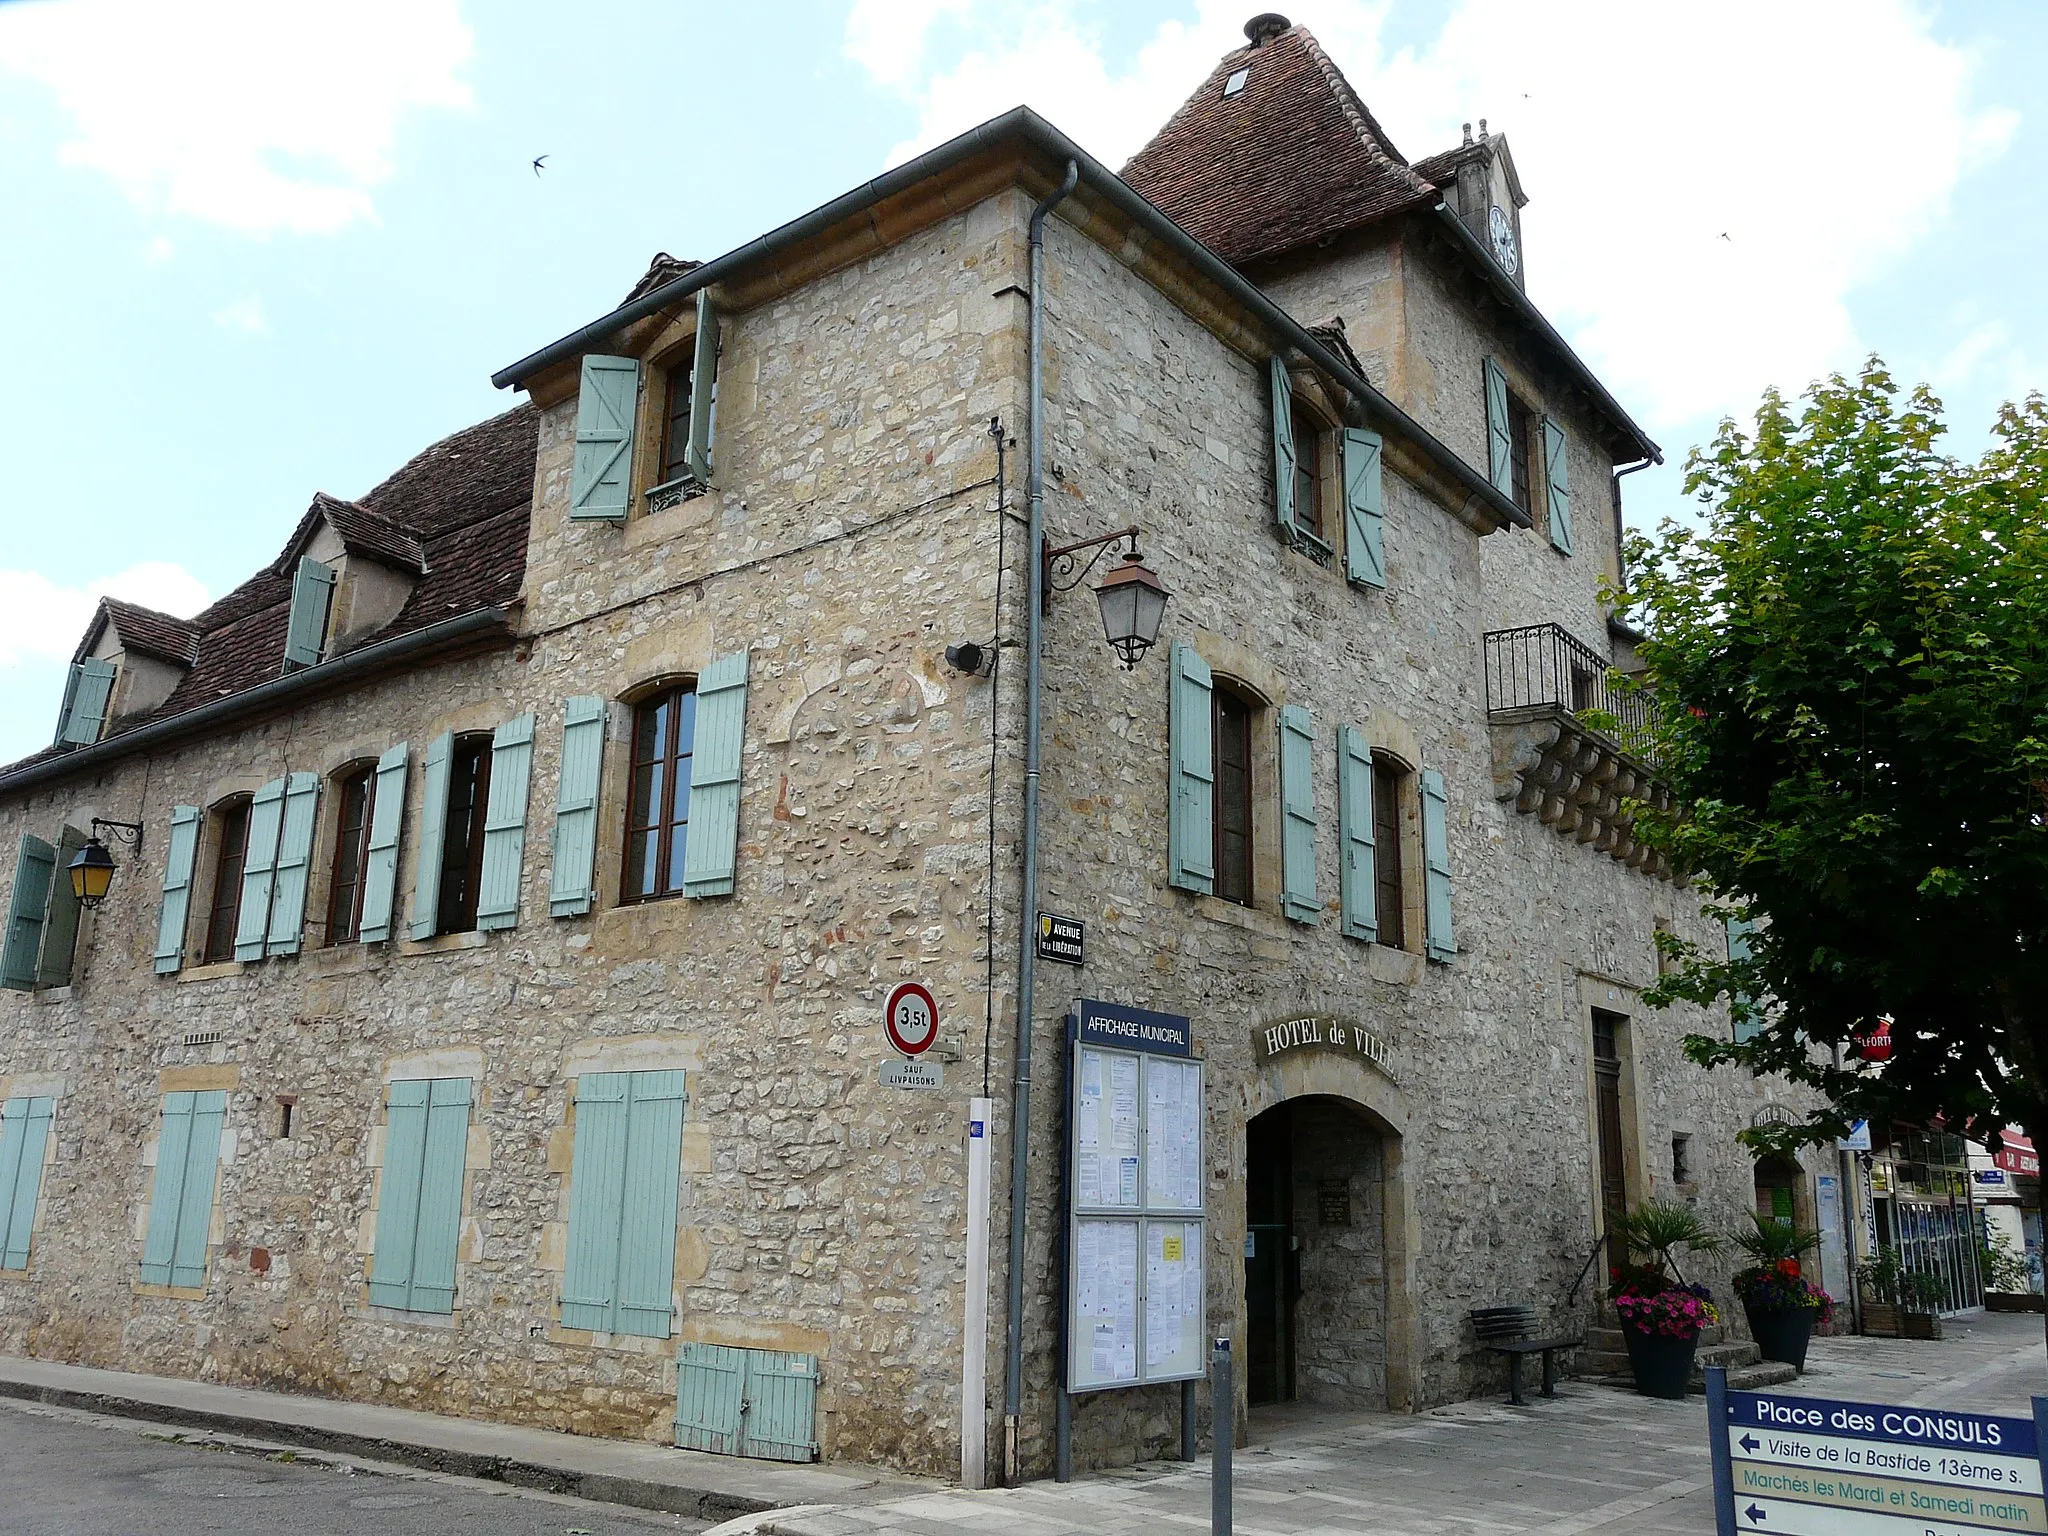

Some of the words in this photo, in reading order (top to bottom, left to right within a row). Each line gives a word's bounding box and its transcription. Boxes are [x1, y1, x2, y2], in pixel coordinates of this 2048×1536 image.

[1053, 923, 1081, 940] AVENUE
[1052, 940, 1081, 957] LIBÉRATION
[900, 1006, 927, 1029] 3,5t
[1088, 1016, 1138, 1038] AFFICHAGE
[1140, 1024, 1185, 1045] MUNICIPAL
[1264, 1018, 1322, 1056] HOTEL
[1329, 1020, 1346, 1045] de
[1353, 1026, 1397, 1074] VILLE
[903, 1065, 924, 1074] SAUF
[1756, 1400, 1824, 1426] Place
[1830, 1408, 1876, 1432] des
[1882, 1413, 2002, 1446] CONSULS
[1768, 1439, 1811, 1458] Visite
[1816, 1445, 1839, 1461] de
[1845, 1447, 1861, 1464] la
[1866, 1450, 1931, 1473] Bastide
[1938, 1458, 2003, 1481] 13ème
[2009, 1469, 2023, 1484] s.
[1744, 1469, 1809, 1493] Marchés
[1813, 1478, 1835, 1497] les
[1838, 1481, 1885, 1503] Mardi
[1889, 1489, 1905, 1506] et
[1910, 1491, 1974, 1515] Samedi
[1980, 1504, 2029, 1522] matin
